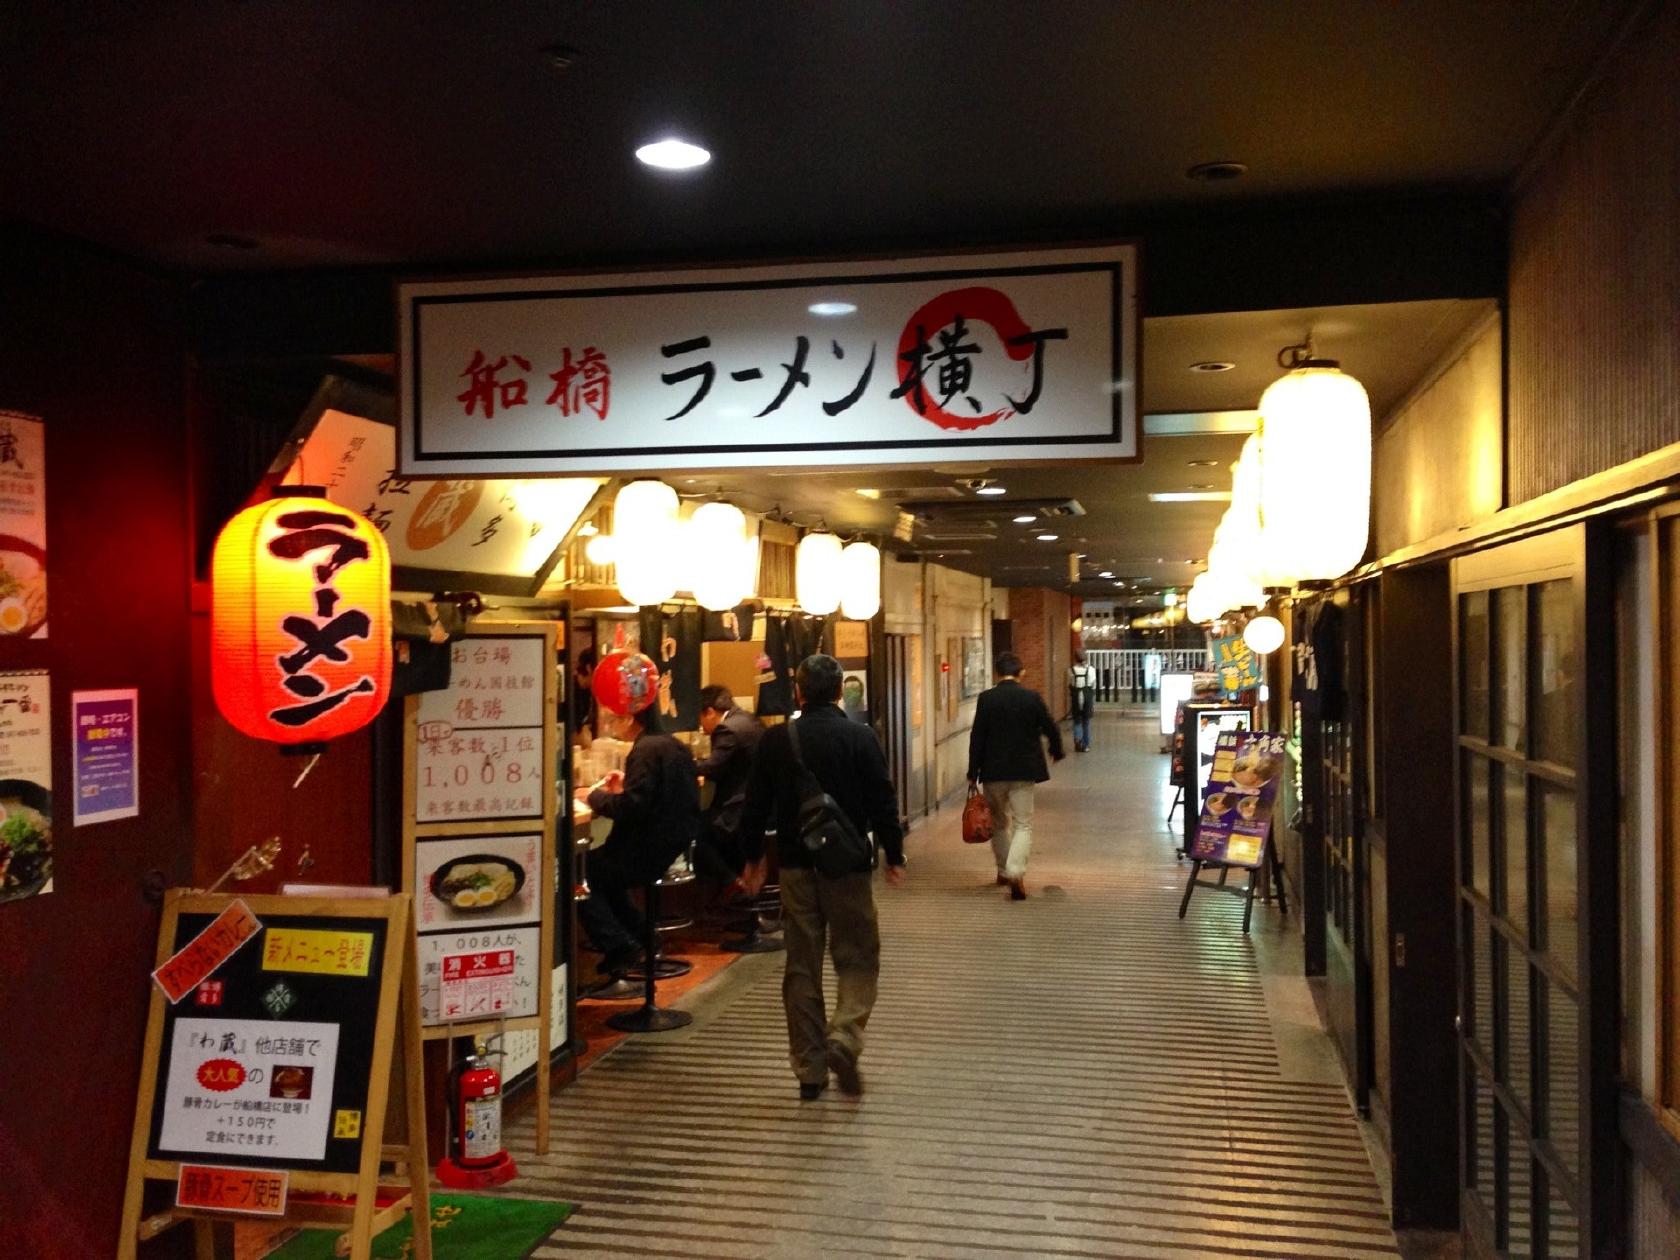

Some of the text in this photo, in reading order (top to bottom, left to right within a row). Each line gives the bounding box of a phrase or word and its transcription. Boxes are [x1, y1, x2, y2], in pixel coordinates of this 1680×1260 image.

[456, 313, 1070, 422] 船橋 ラーメン横丁
[267, 510, 375, 727] ラーメン
[456, 697, 505, 721] 優勝
[448, 952, 511, 971] 消火器
[203, 1068, 264, 1085] 大人気 の
